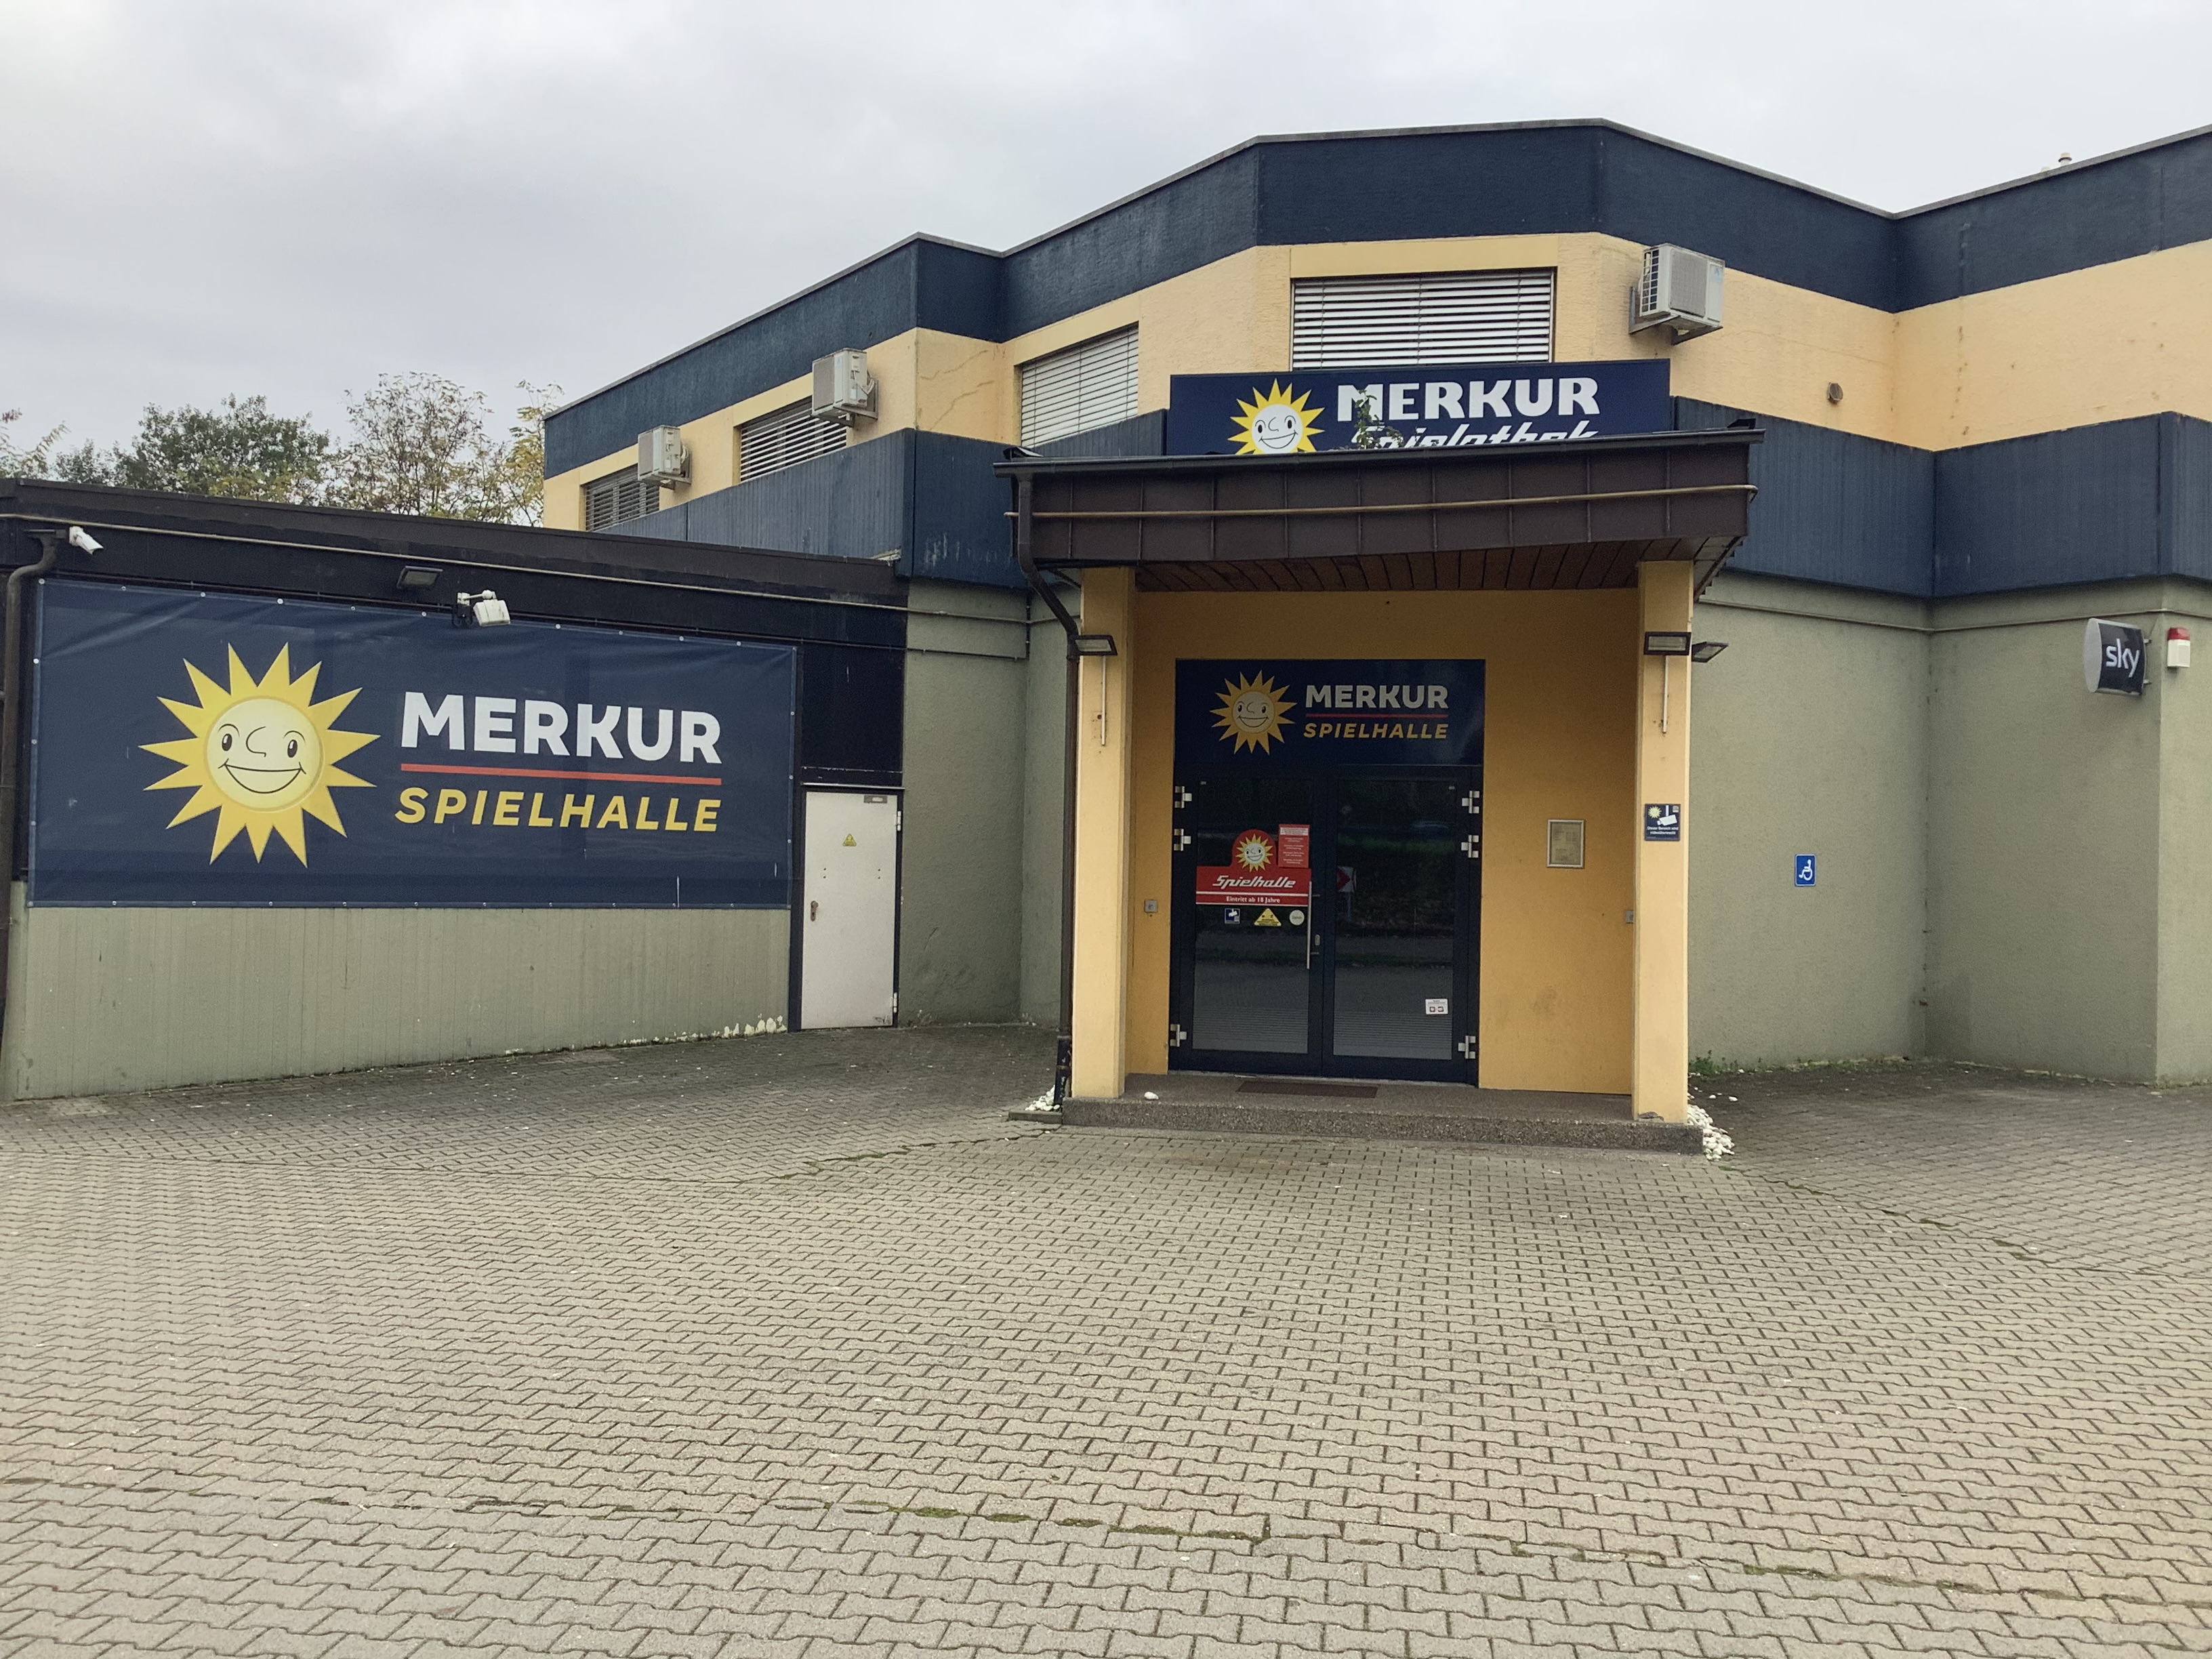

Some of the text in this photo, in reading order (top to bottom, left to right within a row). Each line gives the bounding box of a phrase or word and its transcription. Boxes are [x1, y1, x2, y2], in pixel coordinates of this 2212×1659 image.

[1337, 377, 1601, 422] MERKUR
[2106, 638, 2140, 678] sky
[1305, 684, 1449, 709] MERKUR
[401, 691, 722, 764] MERKUR
[1303, 722, 1449, 739] SPIELHALLE
[394, 787, 722, 832] SPIELHALLE
[1212, 875, 1296, 890] Spielhalle
